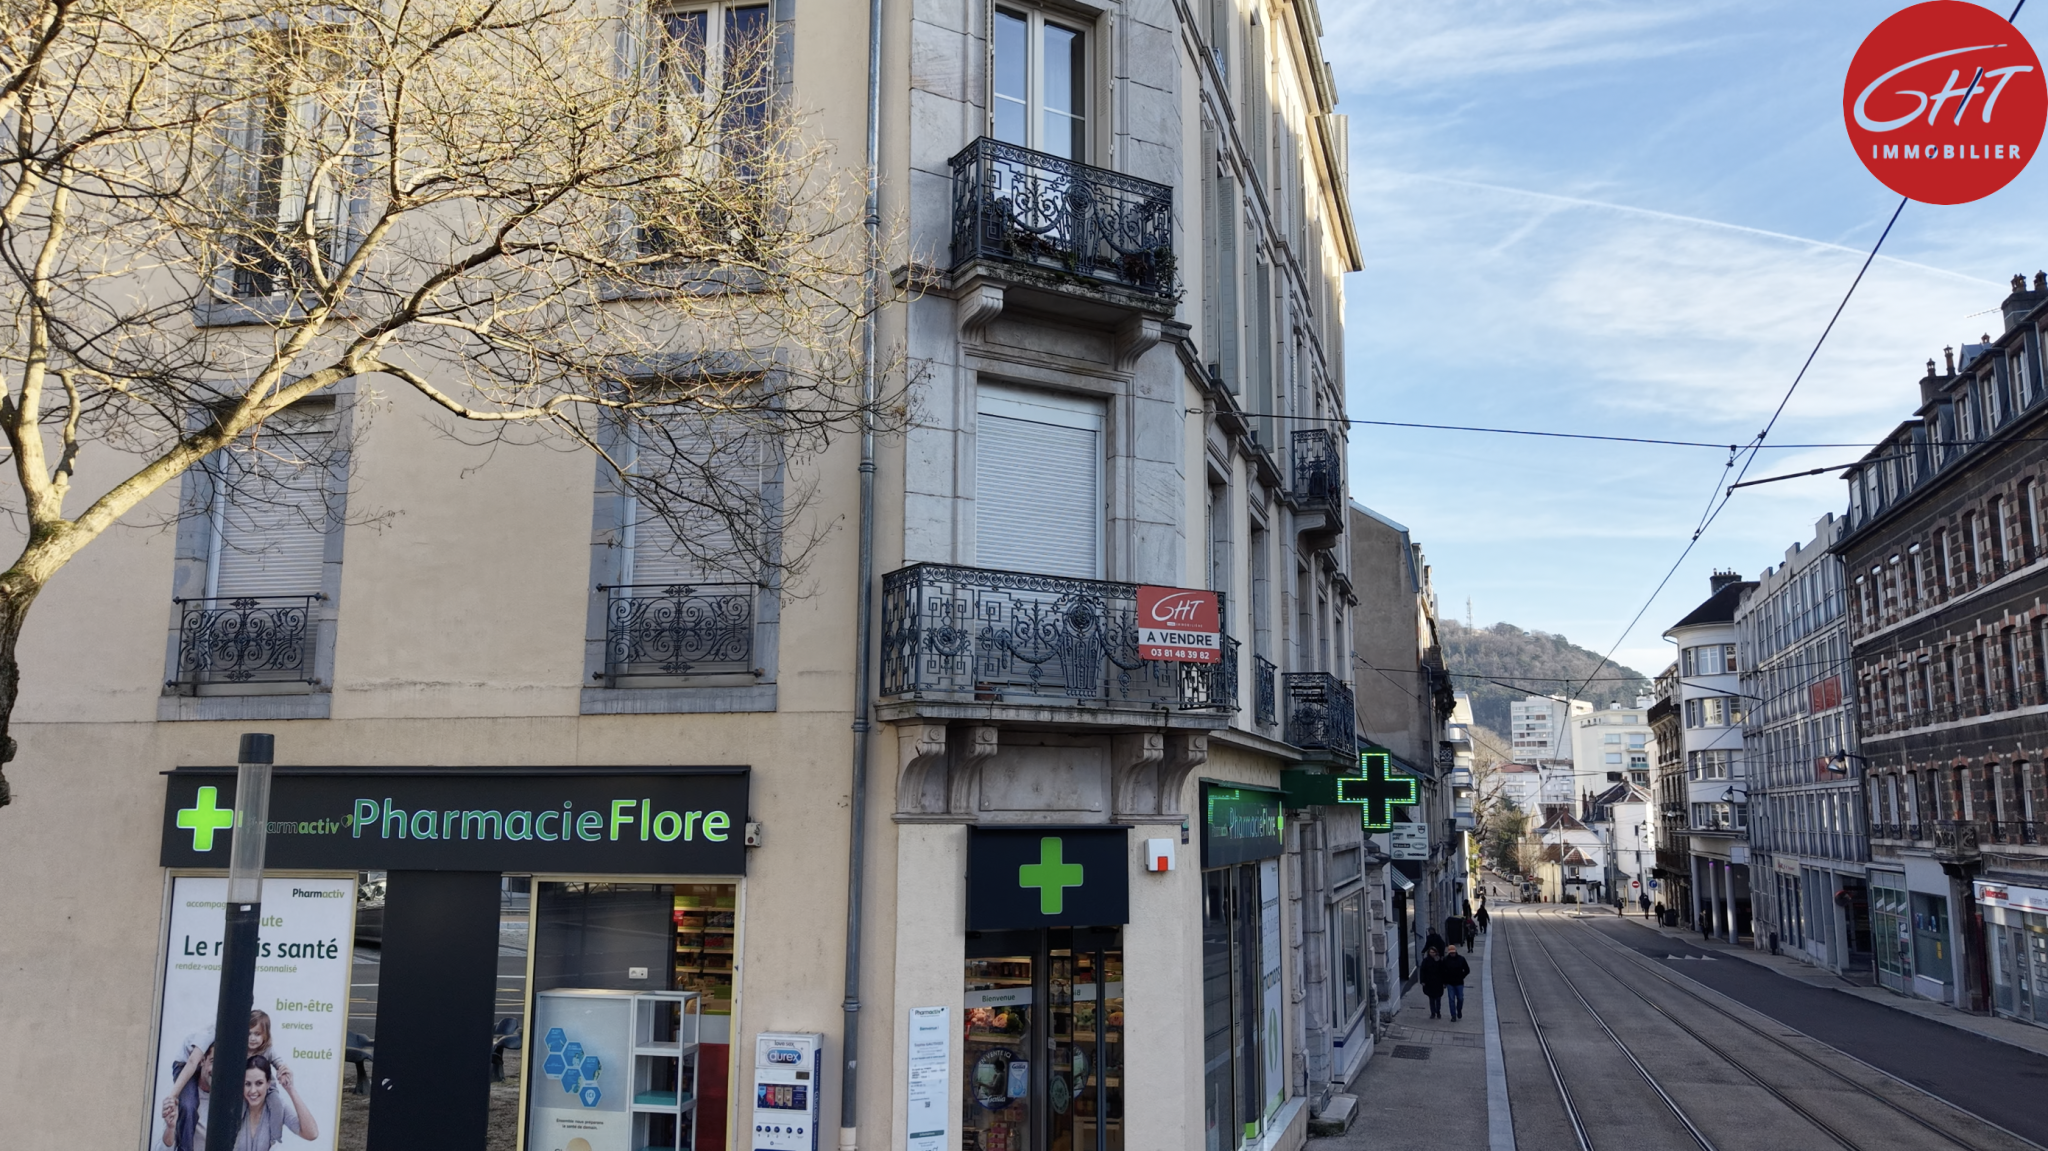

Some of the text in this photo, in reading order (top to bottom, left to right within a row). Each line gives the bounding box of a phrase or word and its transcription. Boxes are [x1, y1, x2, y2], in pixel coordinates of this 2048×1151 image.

[1151, 591, 1205, 622] GHT
[1147, 631, 1212, 646] A VENDRE
[1151, 648, 1210, 660] 03 81 48 39 82
[254, 816, 340, 834] armactiv
[352, 797, 731, 842] Pharmacie Flore
[292, 888, 345, 899] Pharmactiv
[186, 901, 227, 910] accompag
[260, 915, 283, 927] ute
[184, 934, 339, 960] Le ris santé
[174, 961, 222, 971] rendez-vous
[255, 964, 298, 974] rsonnalisé
[981, 993, 1016, 1003] Bienvenue
[275, 998, 334, 1013] bien-être
[281, 1022, 314, 1030] services
[292, 1047, 333, 1060] beauté
[769, 1050, 800, 1062] durex
